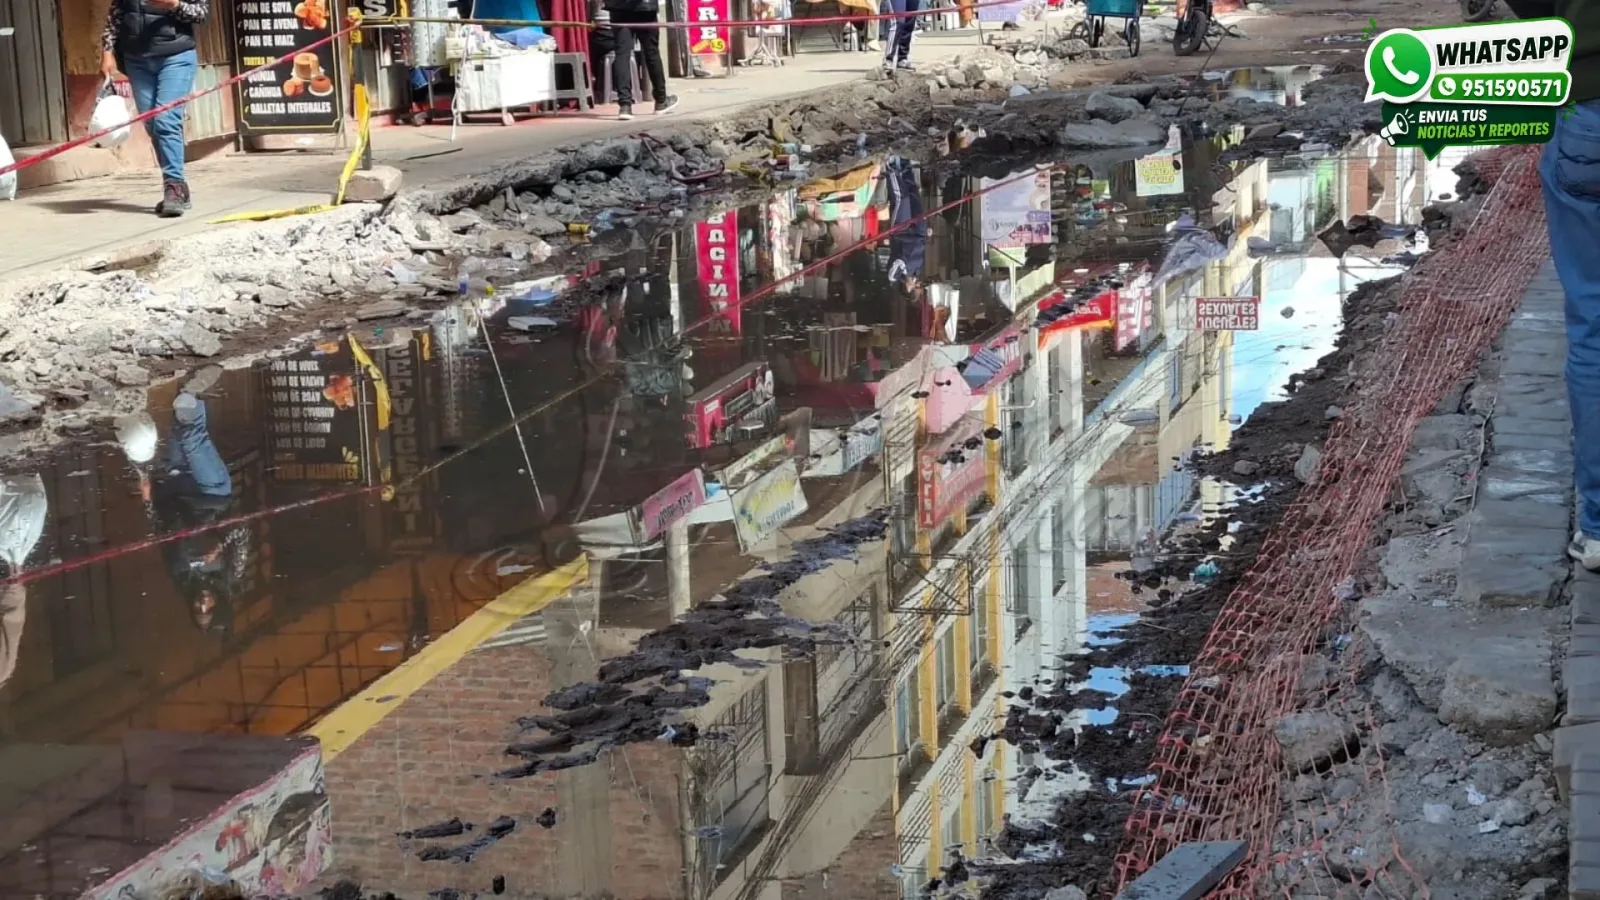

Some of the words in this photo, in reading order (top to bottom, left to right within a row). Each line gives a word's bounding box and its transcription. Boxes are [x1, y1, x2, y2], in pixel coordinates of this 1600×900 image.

[241, 2, 259, 14] PAN
[260, 2, 271, 13] DE
[272, 1, 293, 13] SOYA
[243, 19, 260, 30] PAN
[261, 19, 272, 30] DE
[273, 18, 299, 30] AVENA
[244, 35, 261, 46] PAN
[262, 35, 273, 46] DE
[274, 34, 295, 46] MAIZ
[249, 84, 282, 98] CAÑIHUA
[250, 102, 286, 114] GALLETAS
[287, 101, 331, 113] INTEGRALES
